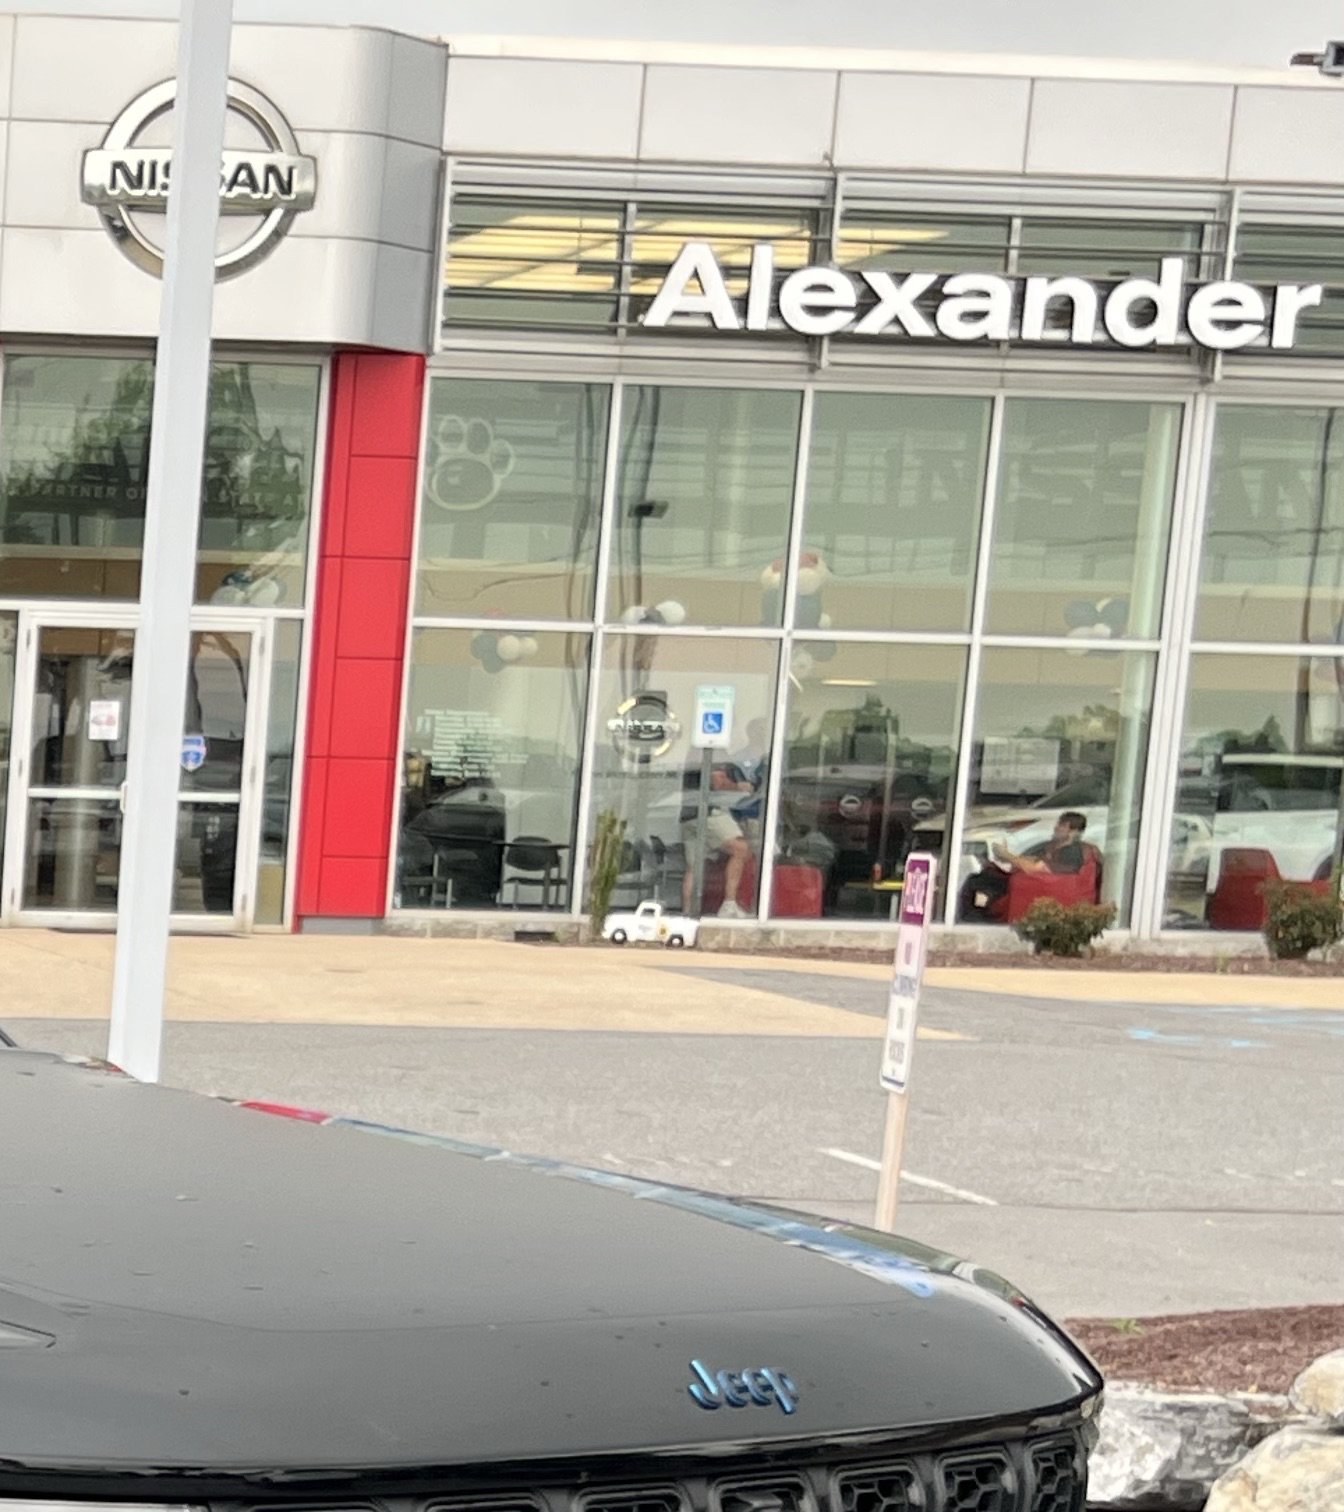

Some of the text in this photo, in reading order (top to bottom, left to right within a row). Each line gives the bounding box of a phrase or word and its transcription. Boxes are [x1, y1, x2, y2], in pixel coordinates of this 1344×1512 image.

[108, 158, 298, 198] NIAN
[642, 241, 1323, 350] Alexander
[687, 1358, 800, 1416] Jeep
